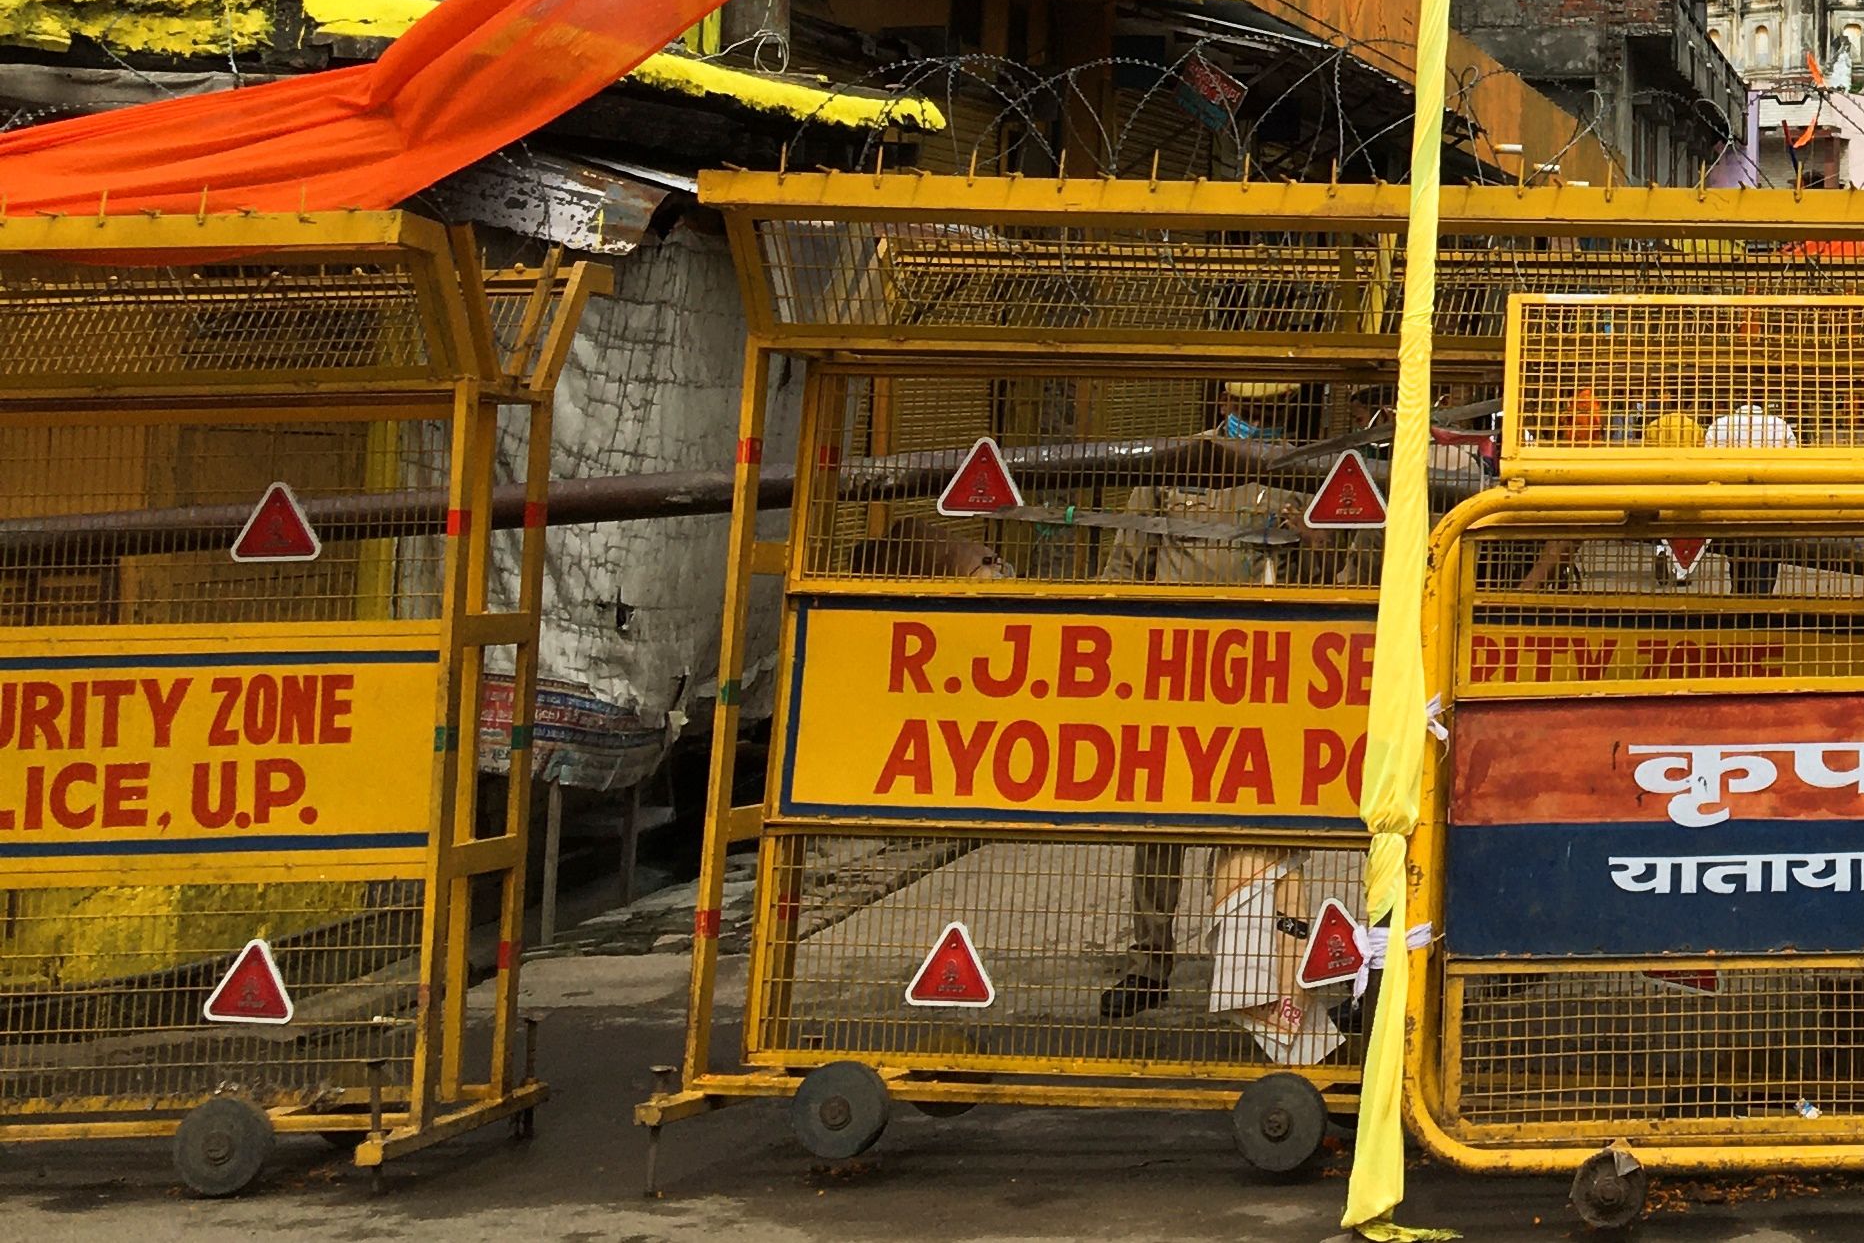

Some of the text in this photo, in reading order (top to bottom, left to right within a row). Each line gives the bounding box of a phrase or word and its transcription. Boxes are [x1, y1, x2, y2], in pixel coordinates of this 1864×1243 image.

[208, 674, 355, 747] ZONE
[0, 758, 319, 833] ICE, U.P.
[874, 719, 1275, 805] AYODHYA
